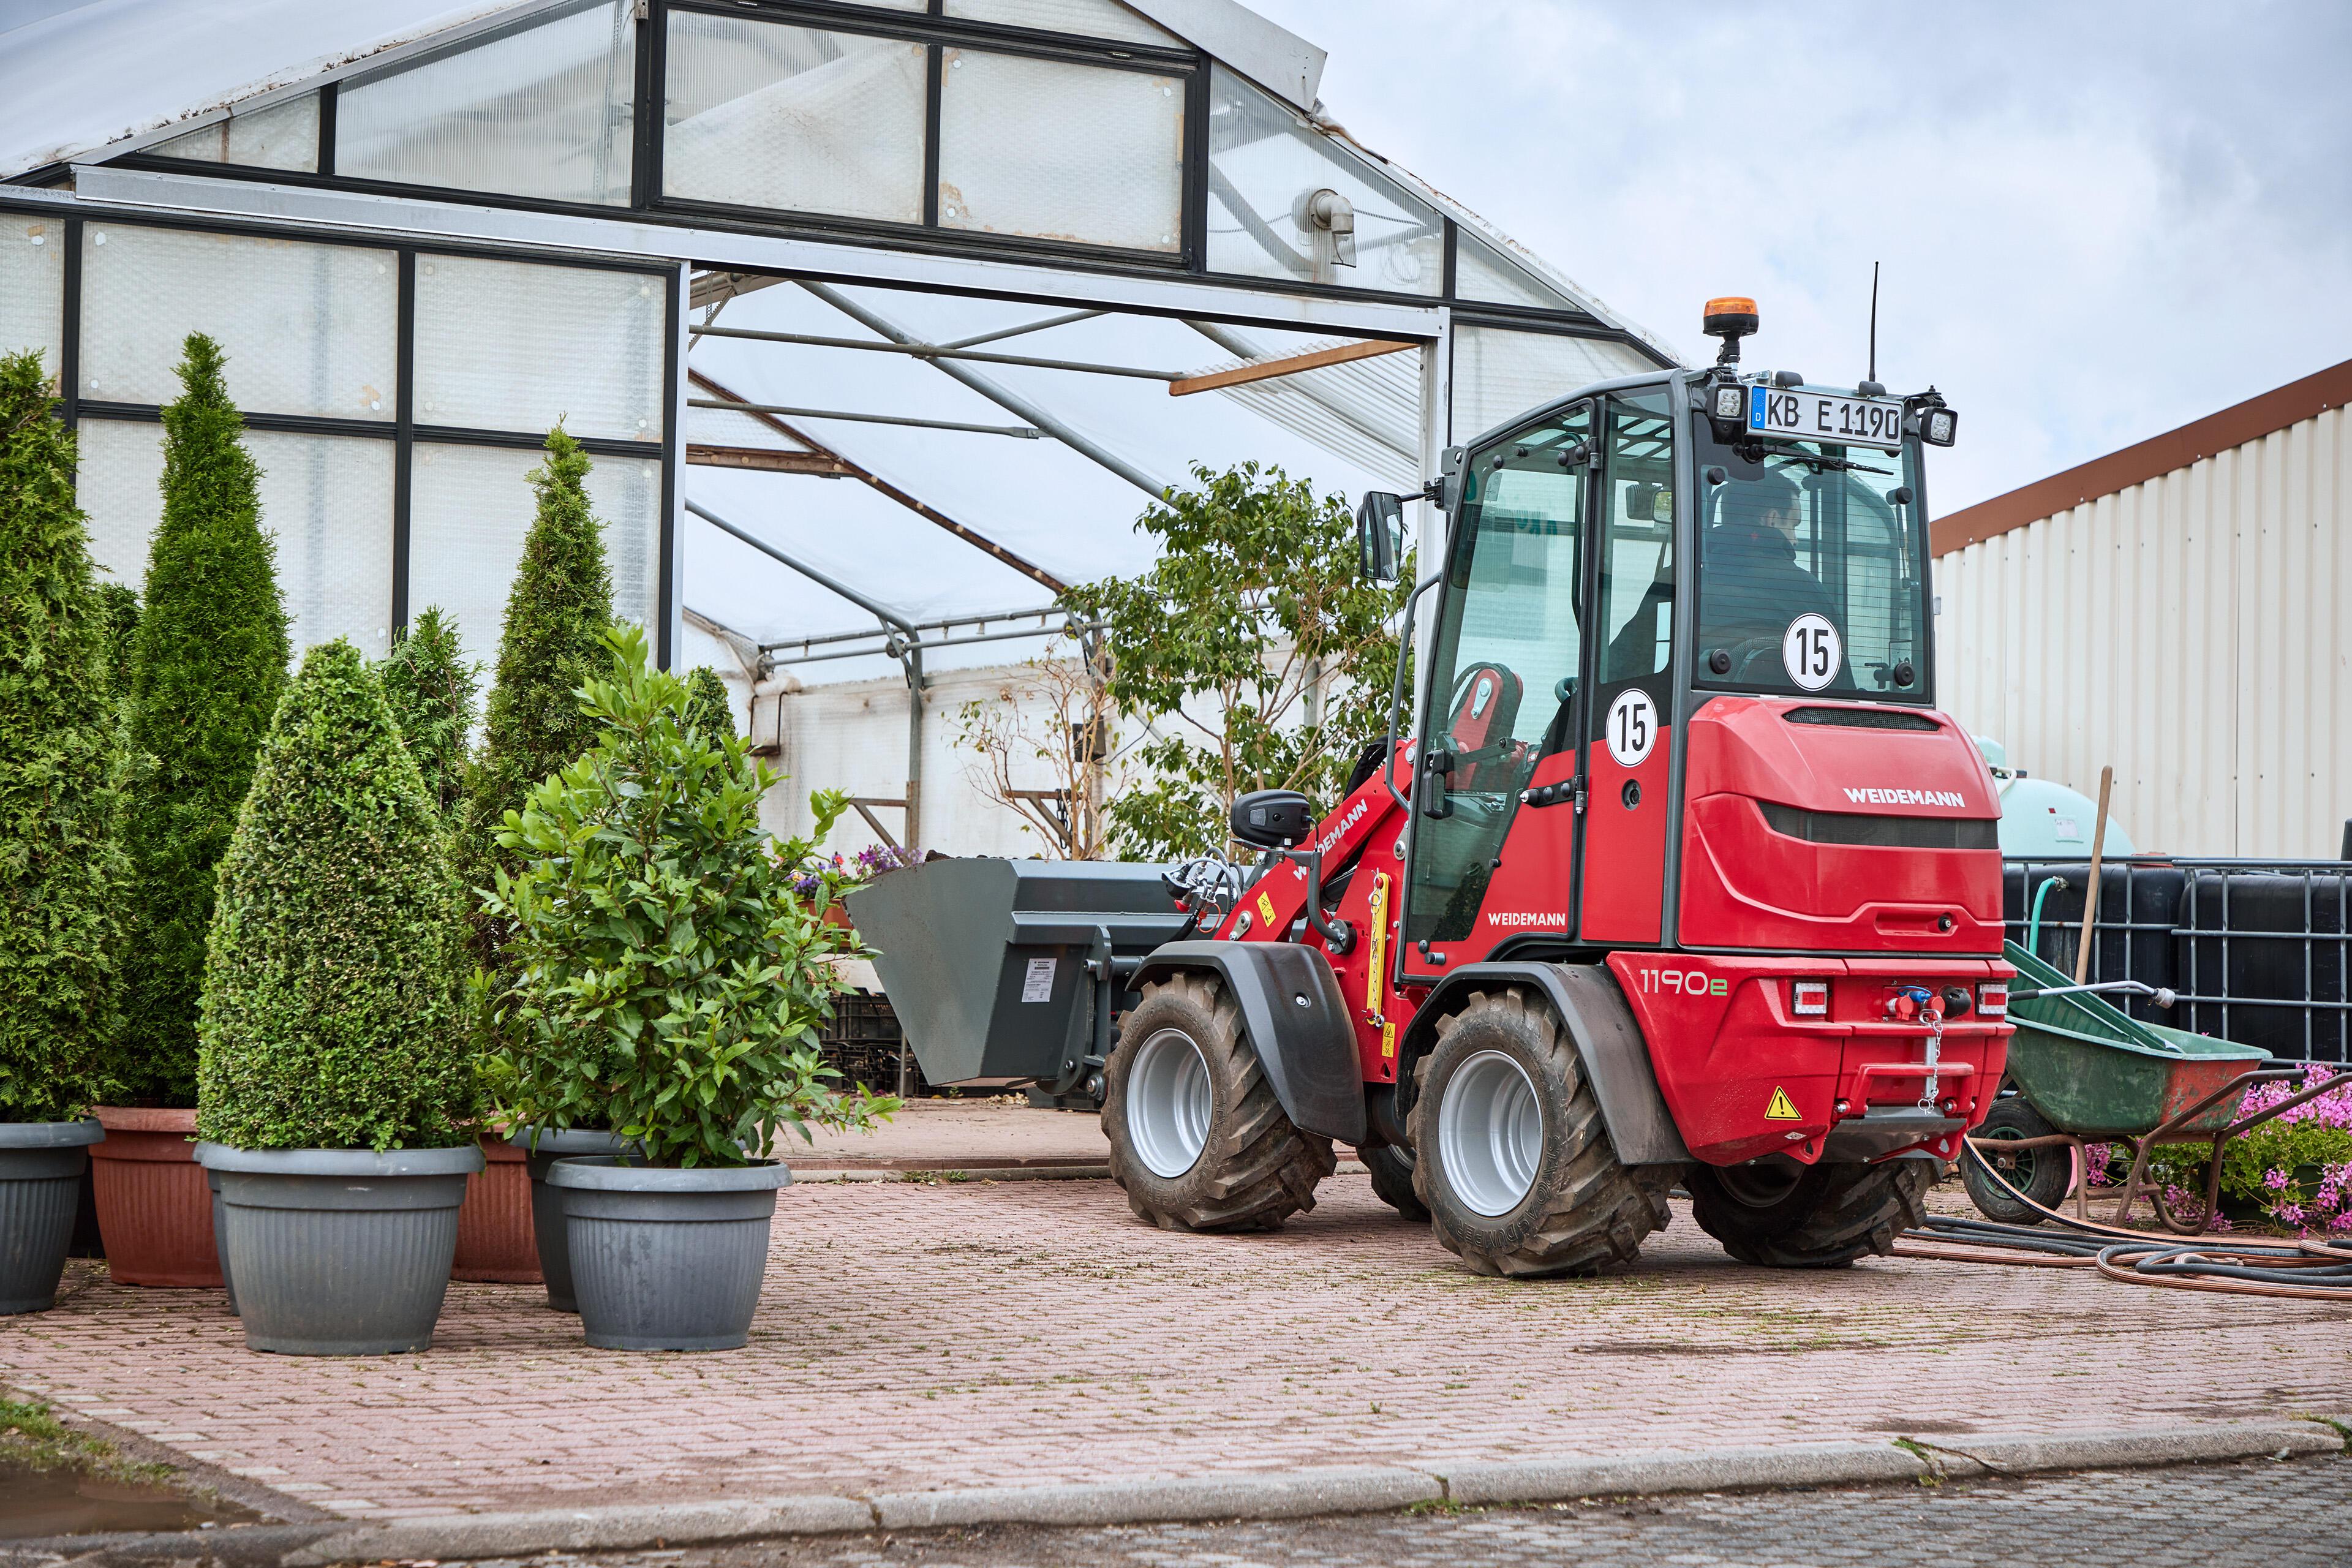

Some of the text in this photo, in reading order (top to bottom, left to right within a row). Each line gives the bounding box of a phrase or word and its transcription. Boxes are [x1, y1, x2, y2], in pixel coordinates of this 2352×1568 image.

[1755, 412, 1762, 421] D
[1768, 394, 1799, 427] KB
[1796, 628, 1829, 676] 15
[1618, 703, 1646, 752] 15
[1842, 788, 1966, 807] WEIDEMANN
[1292, 799, 1368, 881] WDEMANN
[1487, 913, 1566, 926] WEIDEMANN
[1640, 969, 1728, 996] 1190e
